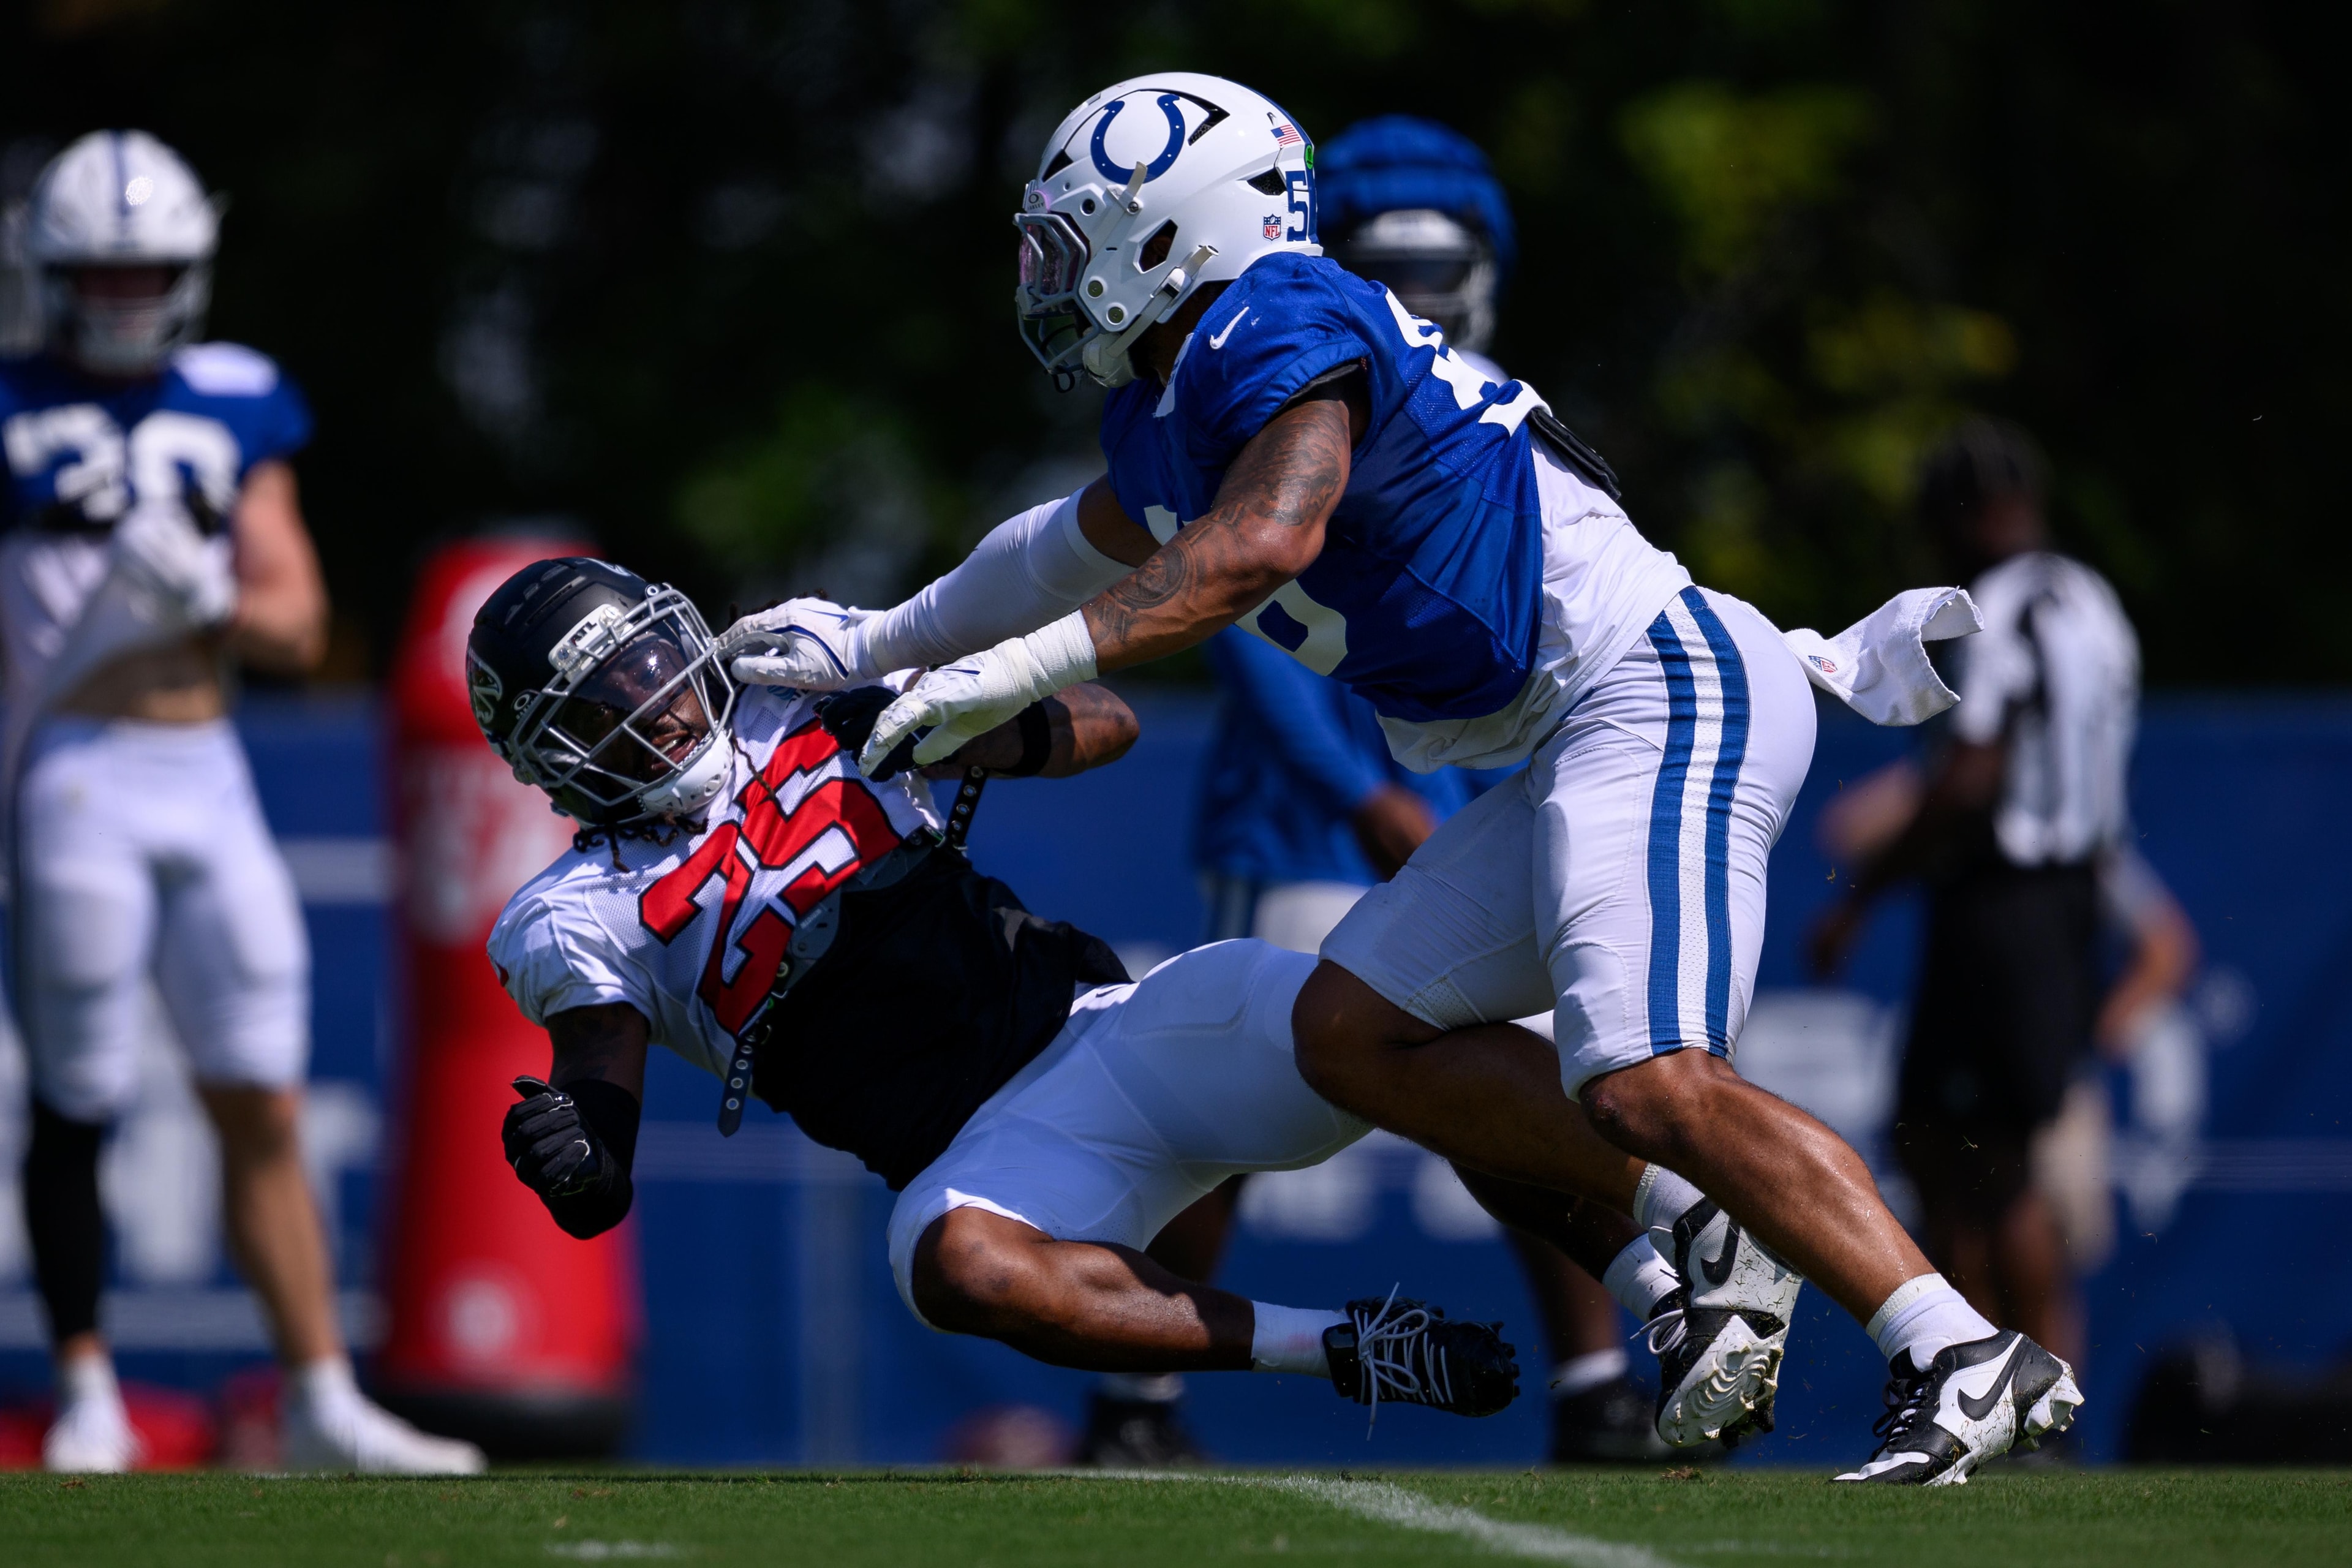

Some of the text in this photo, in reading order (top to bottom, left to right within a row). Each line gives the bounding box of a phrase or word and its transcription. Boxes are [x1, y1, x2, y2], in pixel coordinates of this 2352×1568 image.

[1265, 225, 1280, 238] NFL
[570, 621, 597, 647] ATL
[638, 718, 902, 1038] 25
